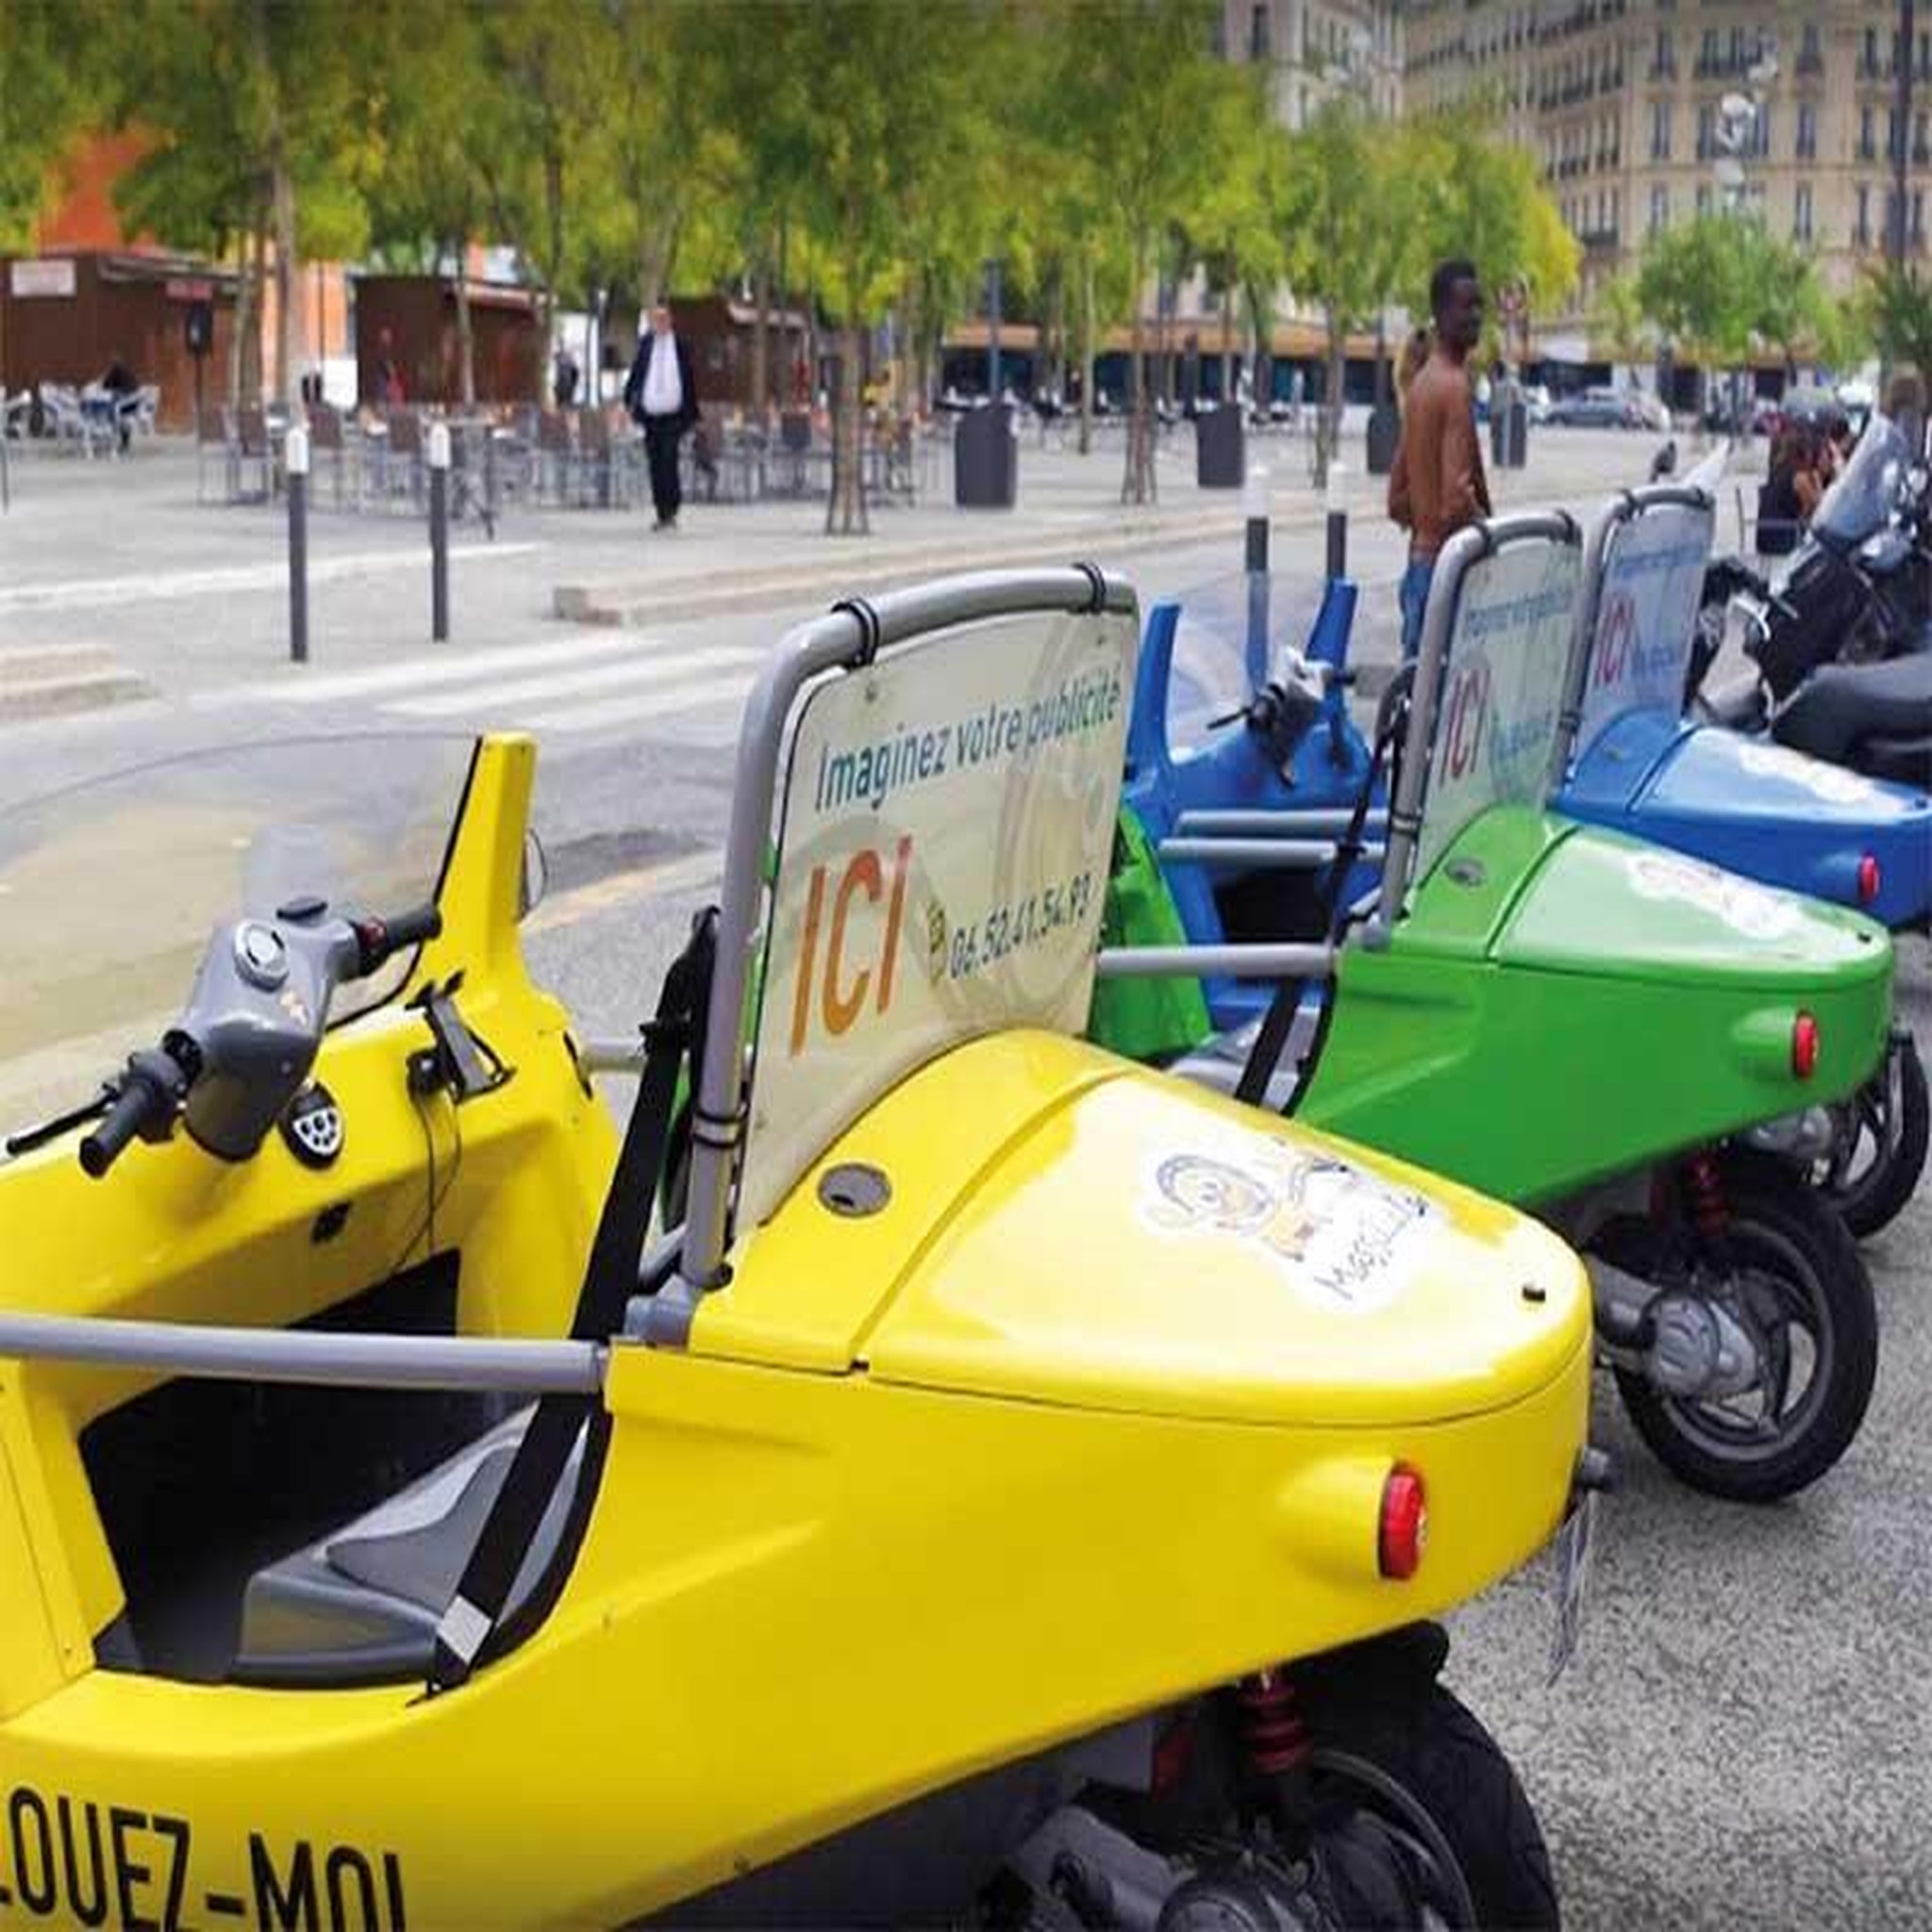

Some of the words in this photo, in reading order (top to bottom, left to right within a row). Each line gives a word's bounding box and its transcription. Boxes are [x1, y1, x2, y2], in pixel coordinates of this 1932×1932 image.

[814, 722, 952, 812] Imaginez
[957, 704, 1022, 767] votre
[1024, 663, 1121, 761] publicité
[0, 1787, 407, 1932] OUEZ-MOI
